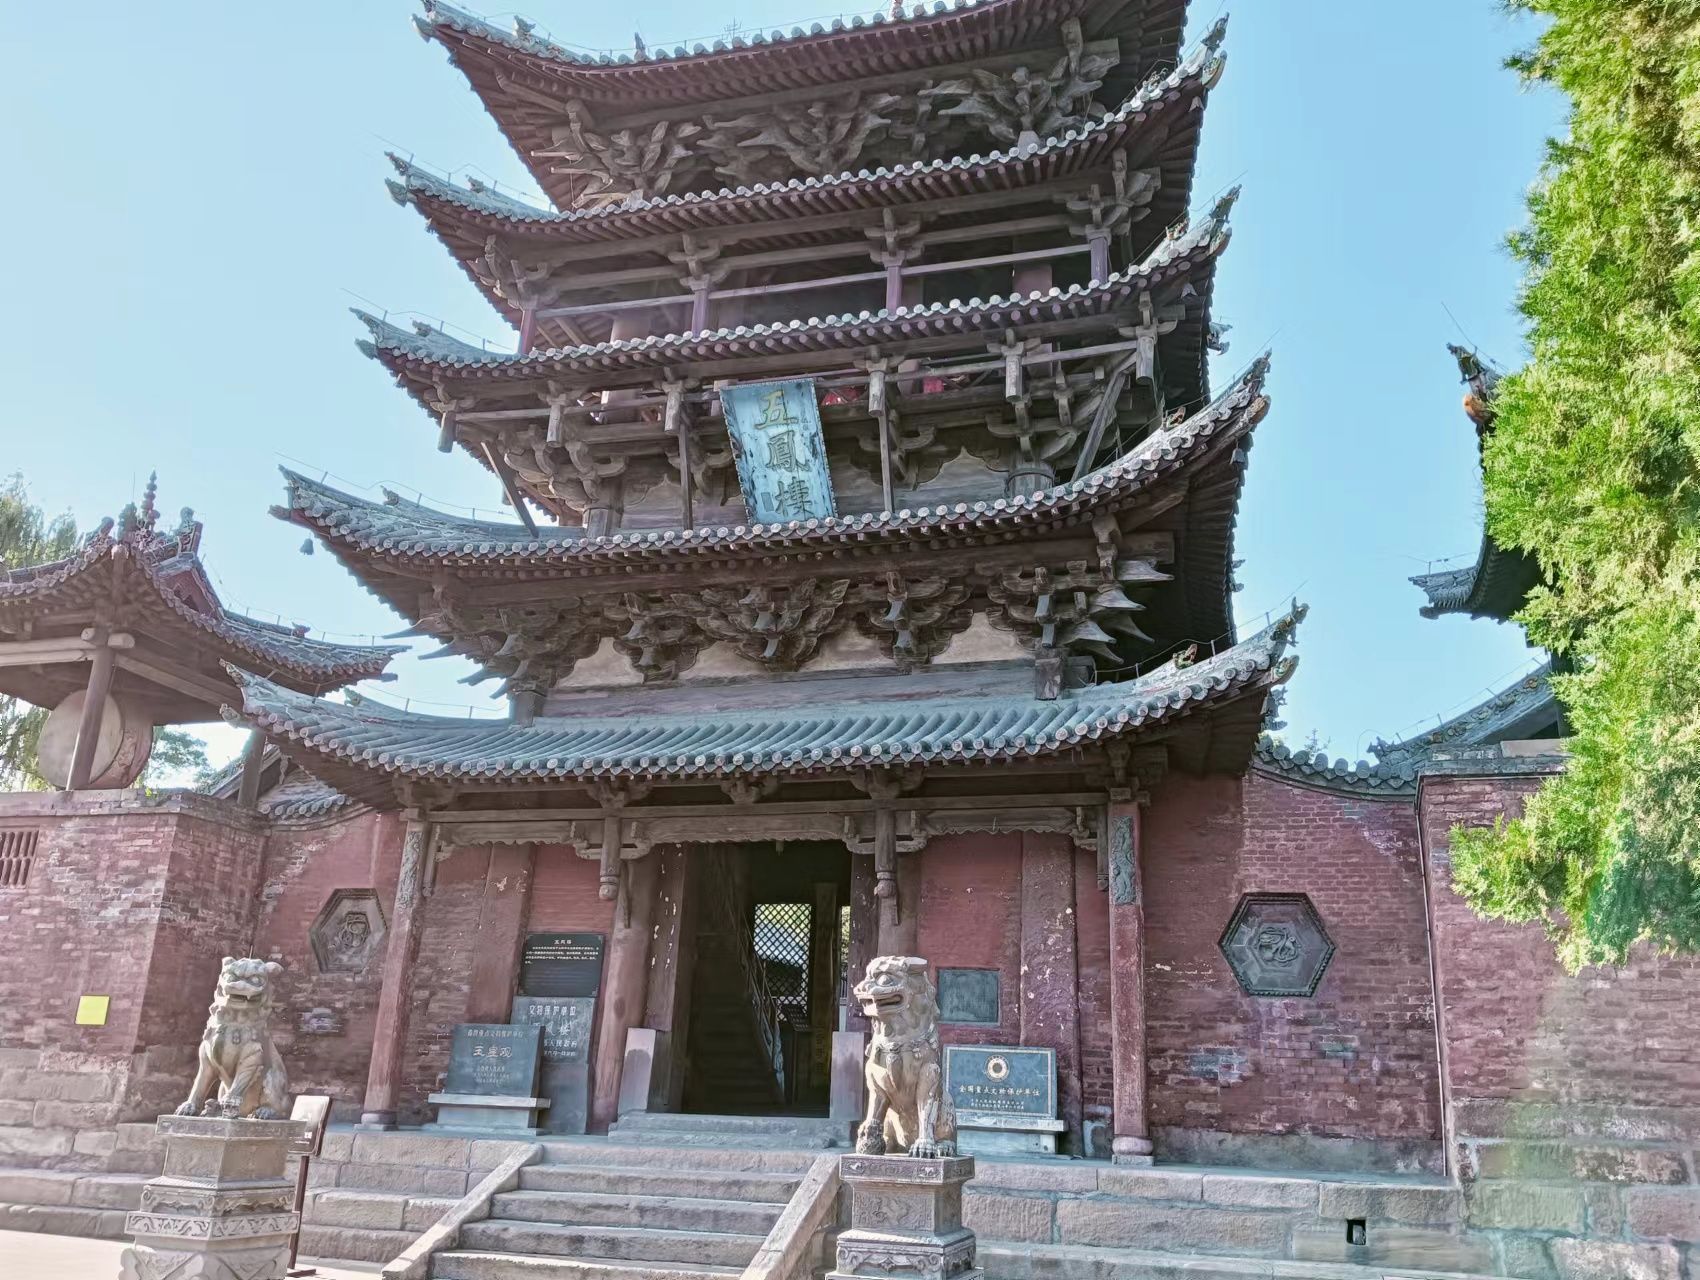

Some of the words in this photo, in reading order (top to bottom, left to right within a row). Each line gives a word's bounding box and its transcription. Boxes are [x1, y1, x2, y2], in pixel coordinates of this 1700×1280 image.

[529, 1005, 577, 1016] 文物保护单位
[959, 1085, 1041, 1097] 全国重点文物保护单位
